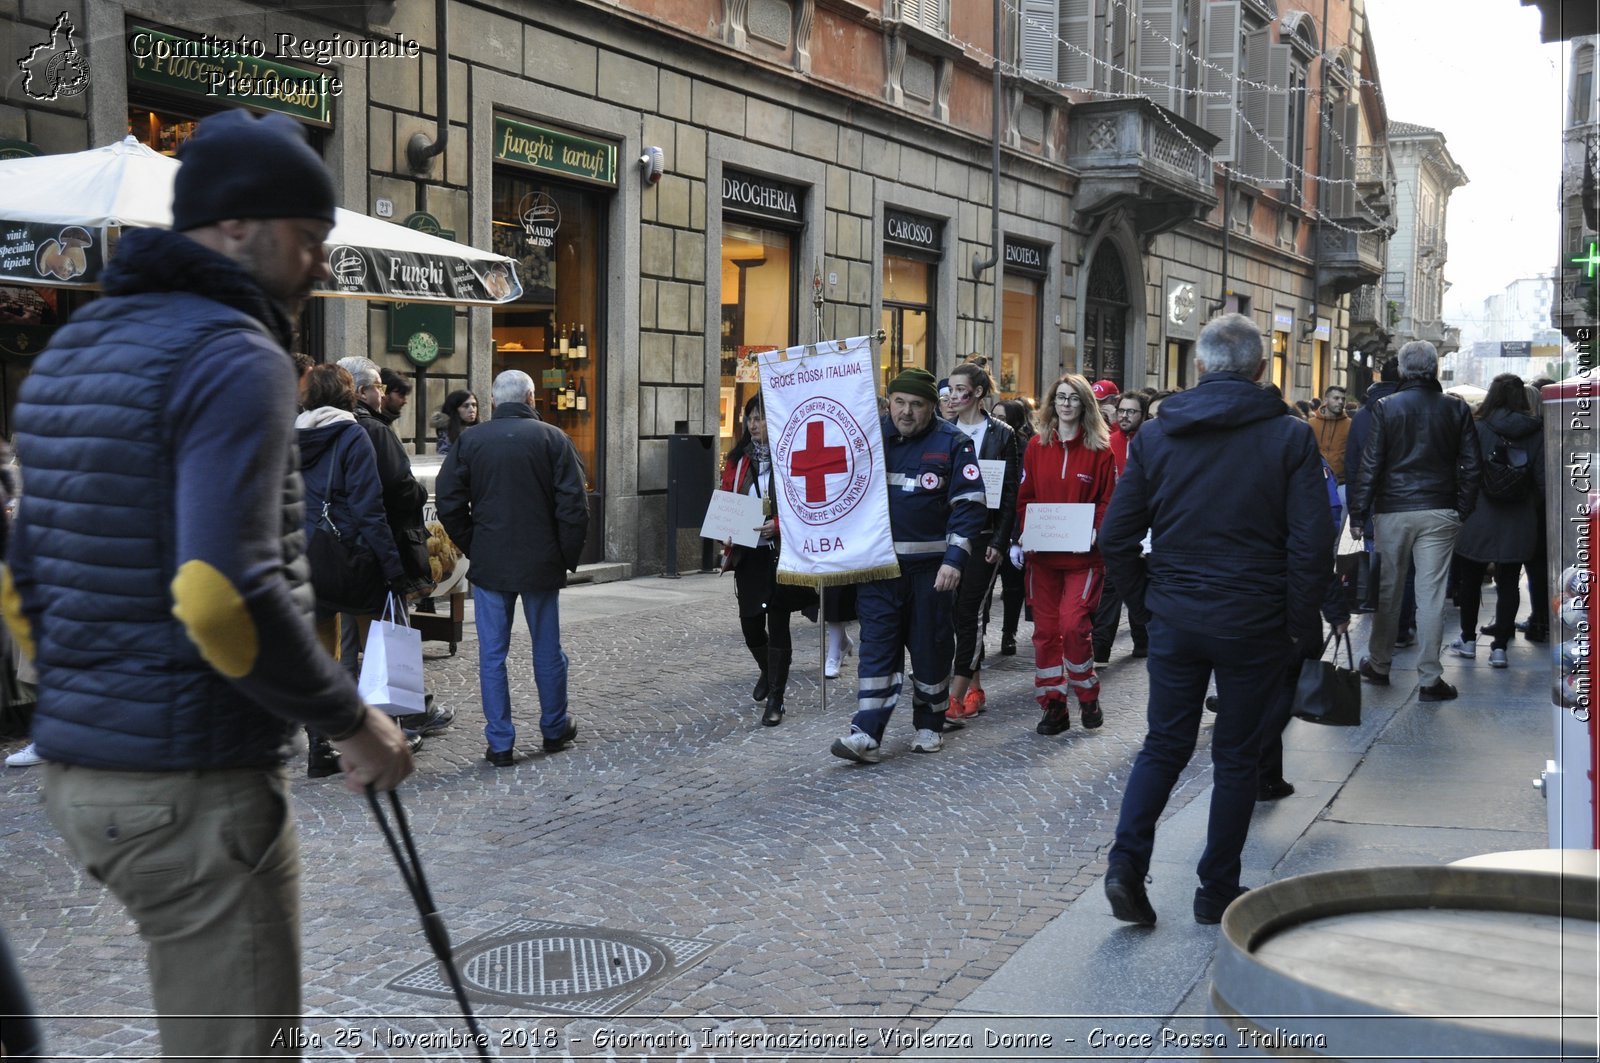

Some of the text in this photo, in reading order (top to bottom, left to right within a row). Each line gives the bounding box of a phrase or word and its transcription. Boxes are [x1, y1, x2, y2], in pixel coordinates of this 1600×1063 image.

[499, 126, 605, 179] funghi tartufi
[721, 177, 798, 214] DROGHERIA
[6, 228, 28, 241] vini e
[525, 223, 554, 238] INAUDI
[887, 217, 933, 245] CAROSSO
[0, 240, 35, 258] specialità
[1006, 243, 1041, 267] ENOTECA
[3, 255, 31, 271] tipiche
[388, 256, 444, 290] Funghi
[337, 275, 363, 286] INAUDI
[769, 361, 863, 389] CROCE ROSSA ITALIANA
[778, 415, 801, 462] CONVENZIONE
[805, 401, 826, 414] GINEVRA
[826, 403, 836, 414] 22
[835, 409, 857, 437] AGOSTO
[830, 473, 867, 517] VOLONTARIE
[802, 536, 845, 554] ALBA
